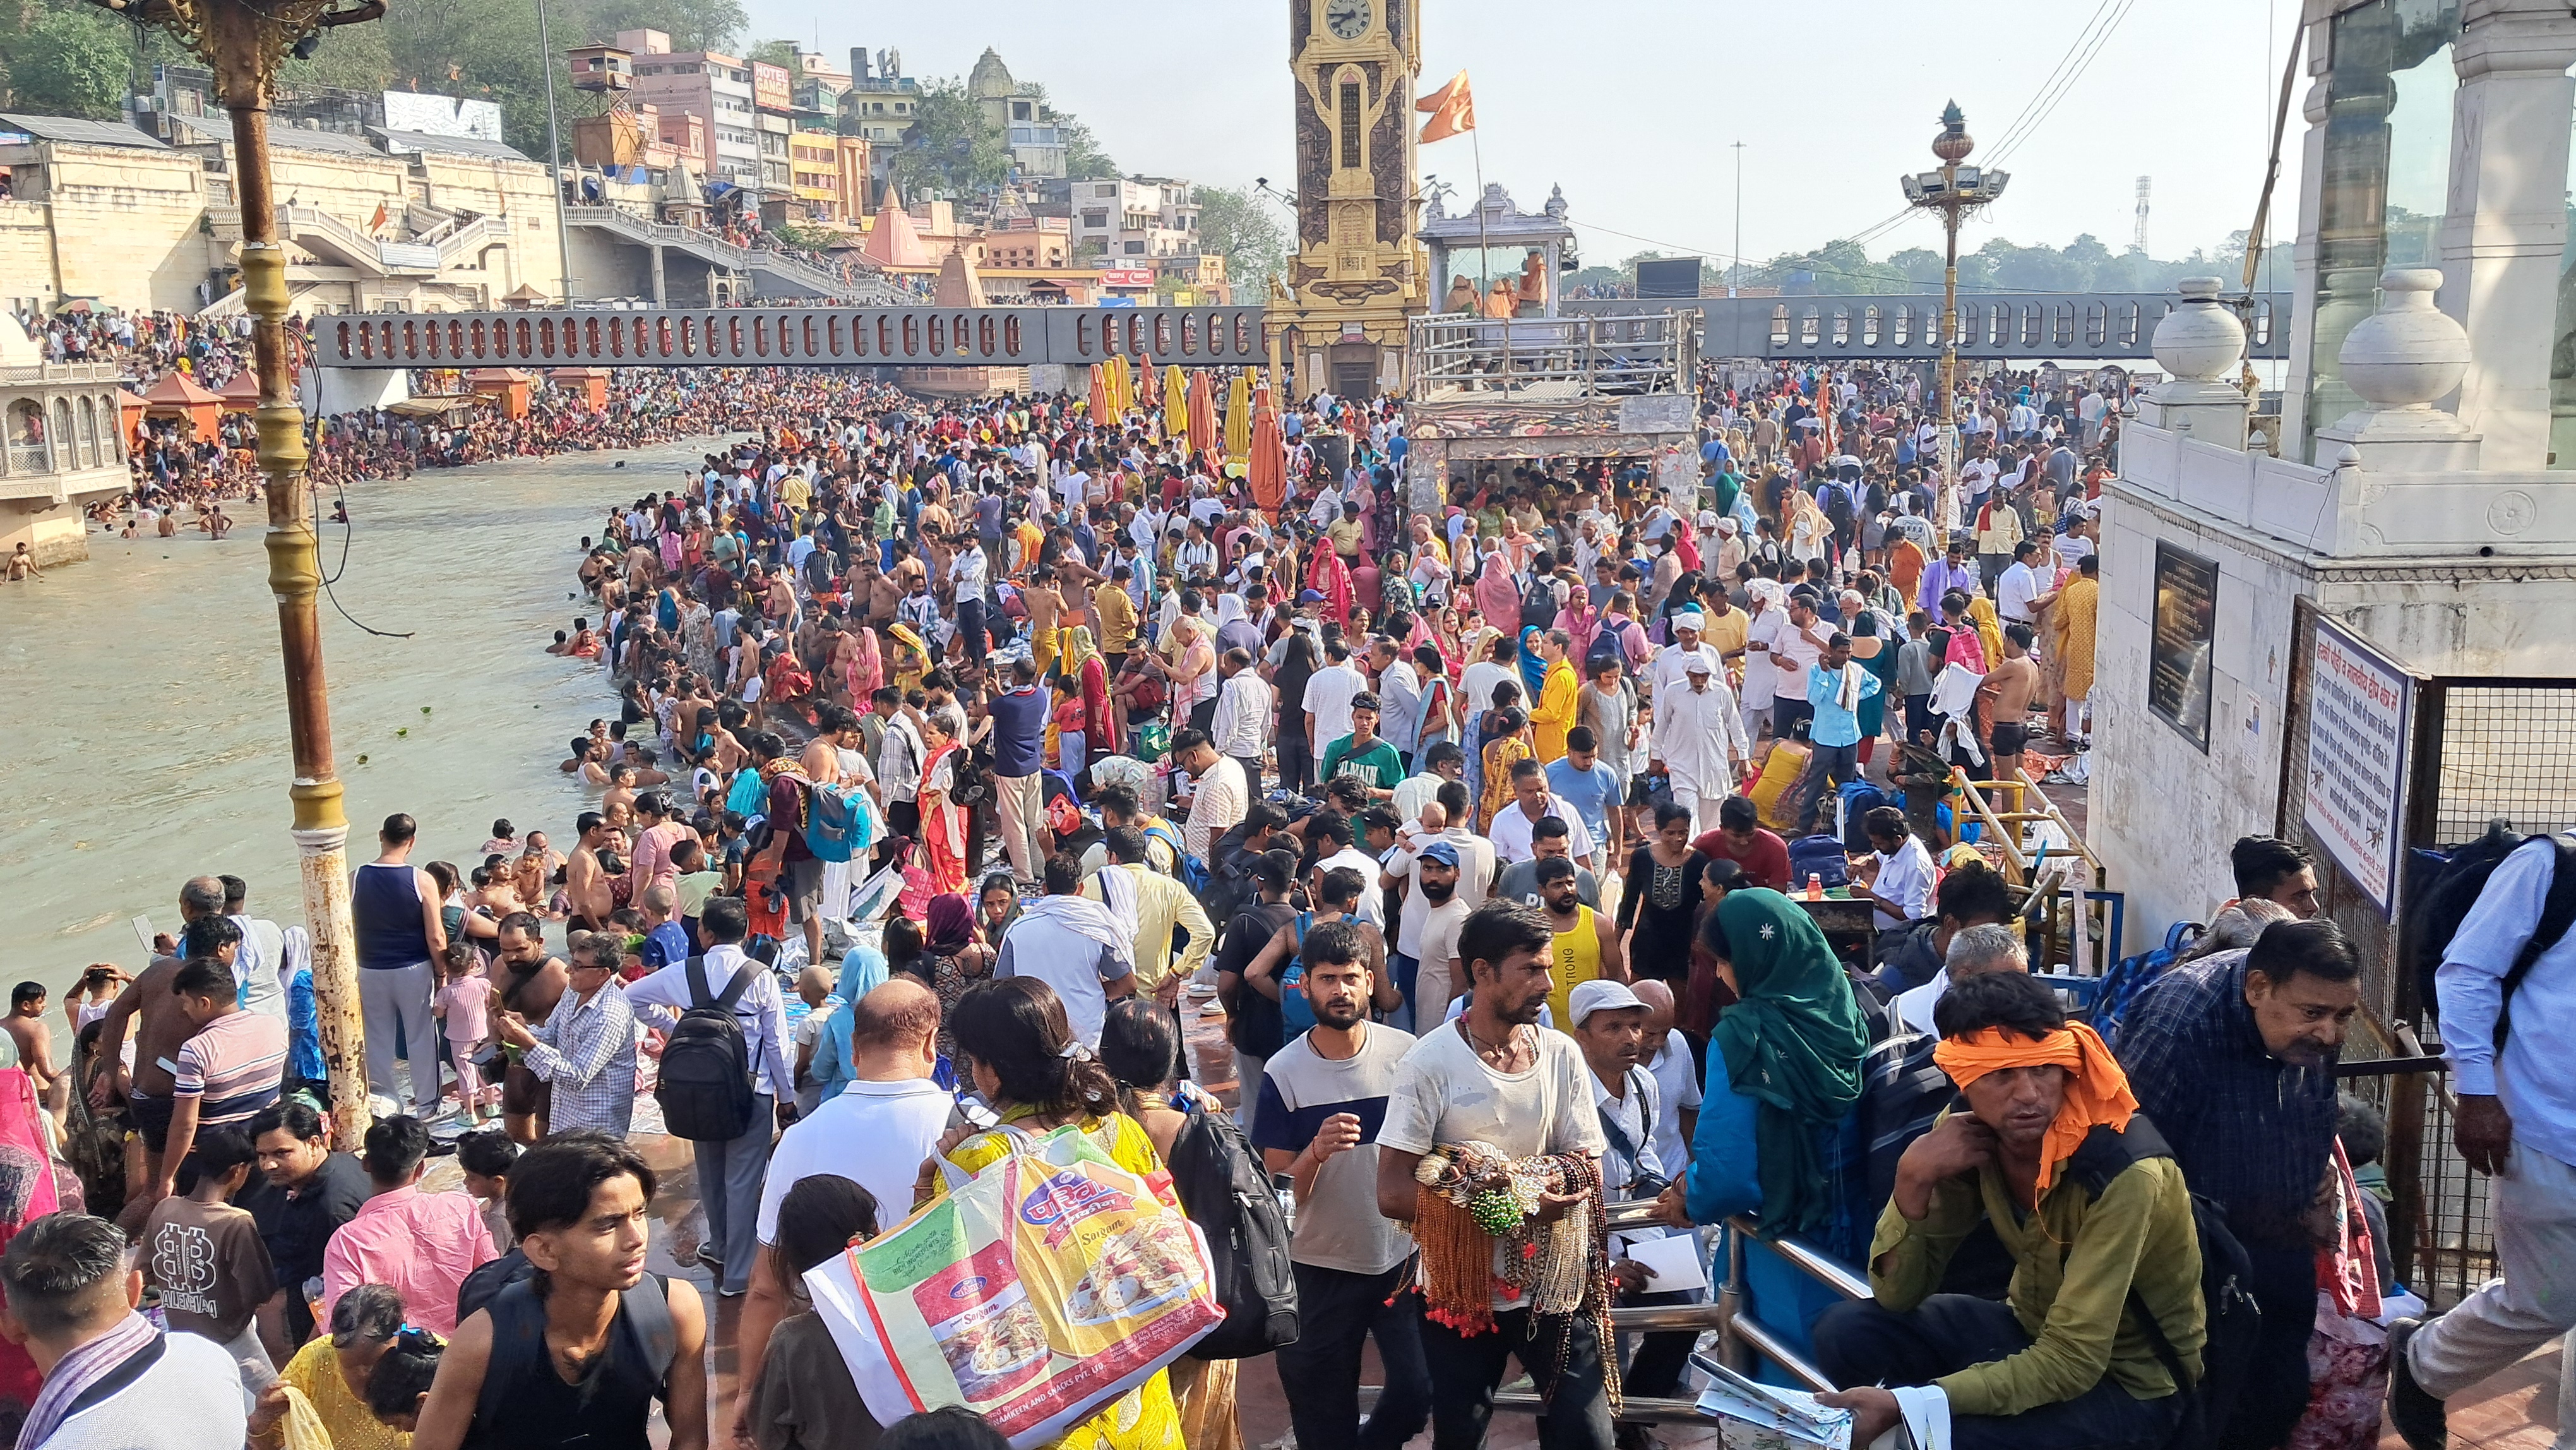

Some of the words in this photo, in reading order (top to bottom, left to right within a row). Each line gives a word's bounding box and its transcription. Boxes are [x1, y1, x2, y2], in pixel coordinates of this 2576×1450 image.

[756, 64, 789, 84] HOTEL
[756, 76, 789, 97] GANGA
[757, 91, 789, 109] DARSHAN
[2341, 659, 2347, 676] व
[2390, 689, 2399, 714] में
[1027, 1180, 1109, 1220] परिवा
[1081, 1218, 1125, 1246] Sargam
[892, 1262, 907, 1276] RICH
[906, 1237, 940, 1266] INGREDIENTS
[963, 1303, 999, 1324] Sargam
[993, 1403, 1030, 1426] NAMKEEN
[1030, 1393, 1047, 1408] AND
[1047, 1377, 1074, 1398] SNACKS
[1074, 1371, 1091, 1383] PVT.
